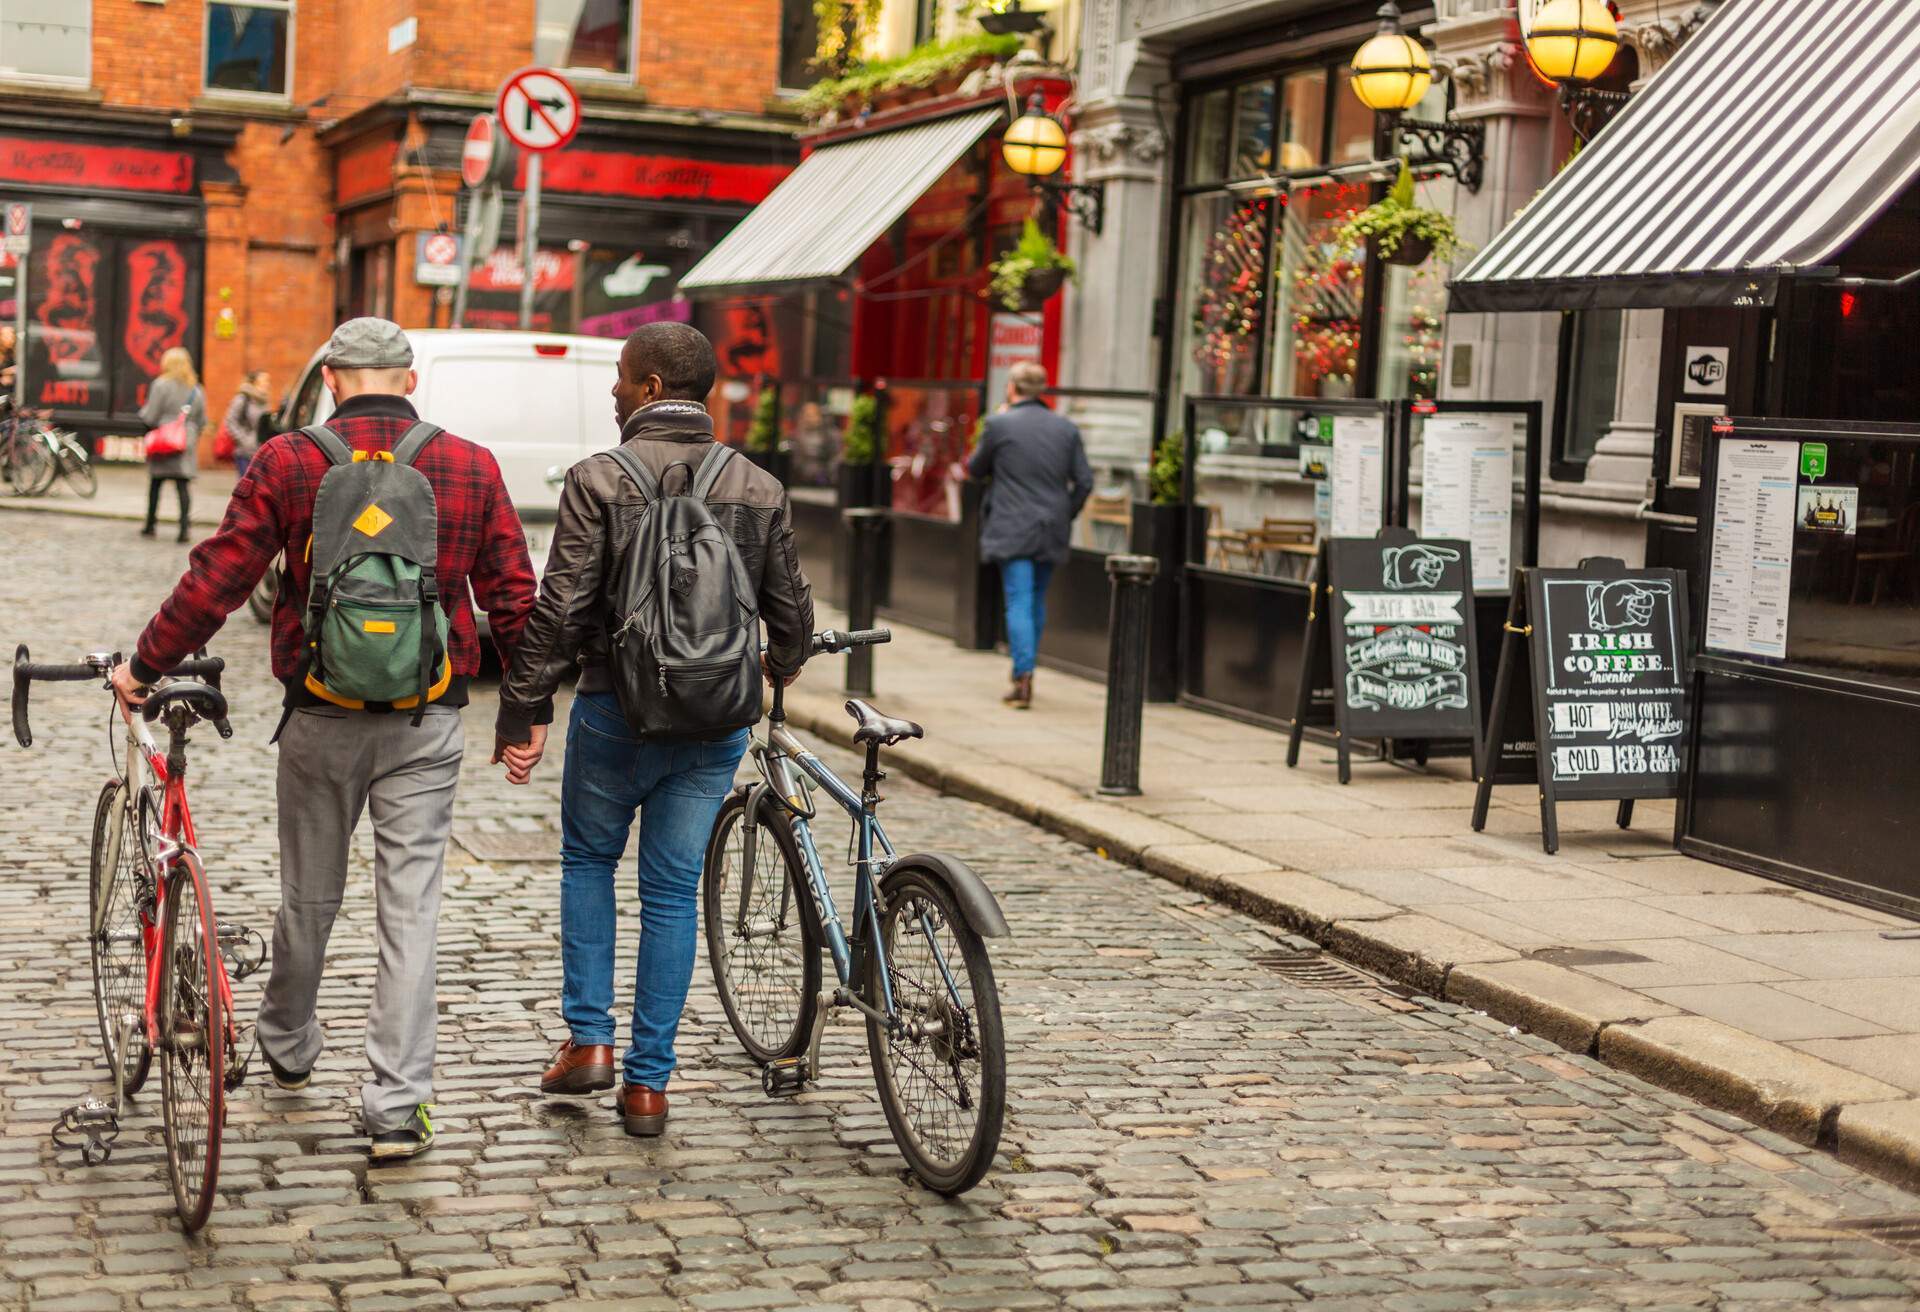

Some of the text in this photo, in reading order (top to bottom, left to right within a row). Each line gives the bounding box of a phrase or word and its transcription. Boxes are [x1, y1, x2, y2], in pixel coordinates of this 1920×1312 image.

[1370, 598, 1437, 617] LATE BAR
[1568, 633, 1654, 650] IRISH
[1387, 682, 1426, 707] FOOD
[1568, 705, 1594, 728] HOT
[1610, 702, 1673, 719] IRISH COFFEE
[1607, 718, 1638, 740] Irish
[1568, 749, 1600, 772] COLD
[1615, 745, 1676, 759] ICED TEA
[1616, 759, 1647, 774] ICED
